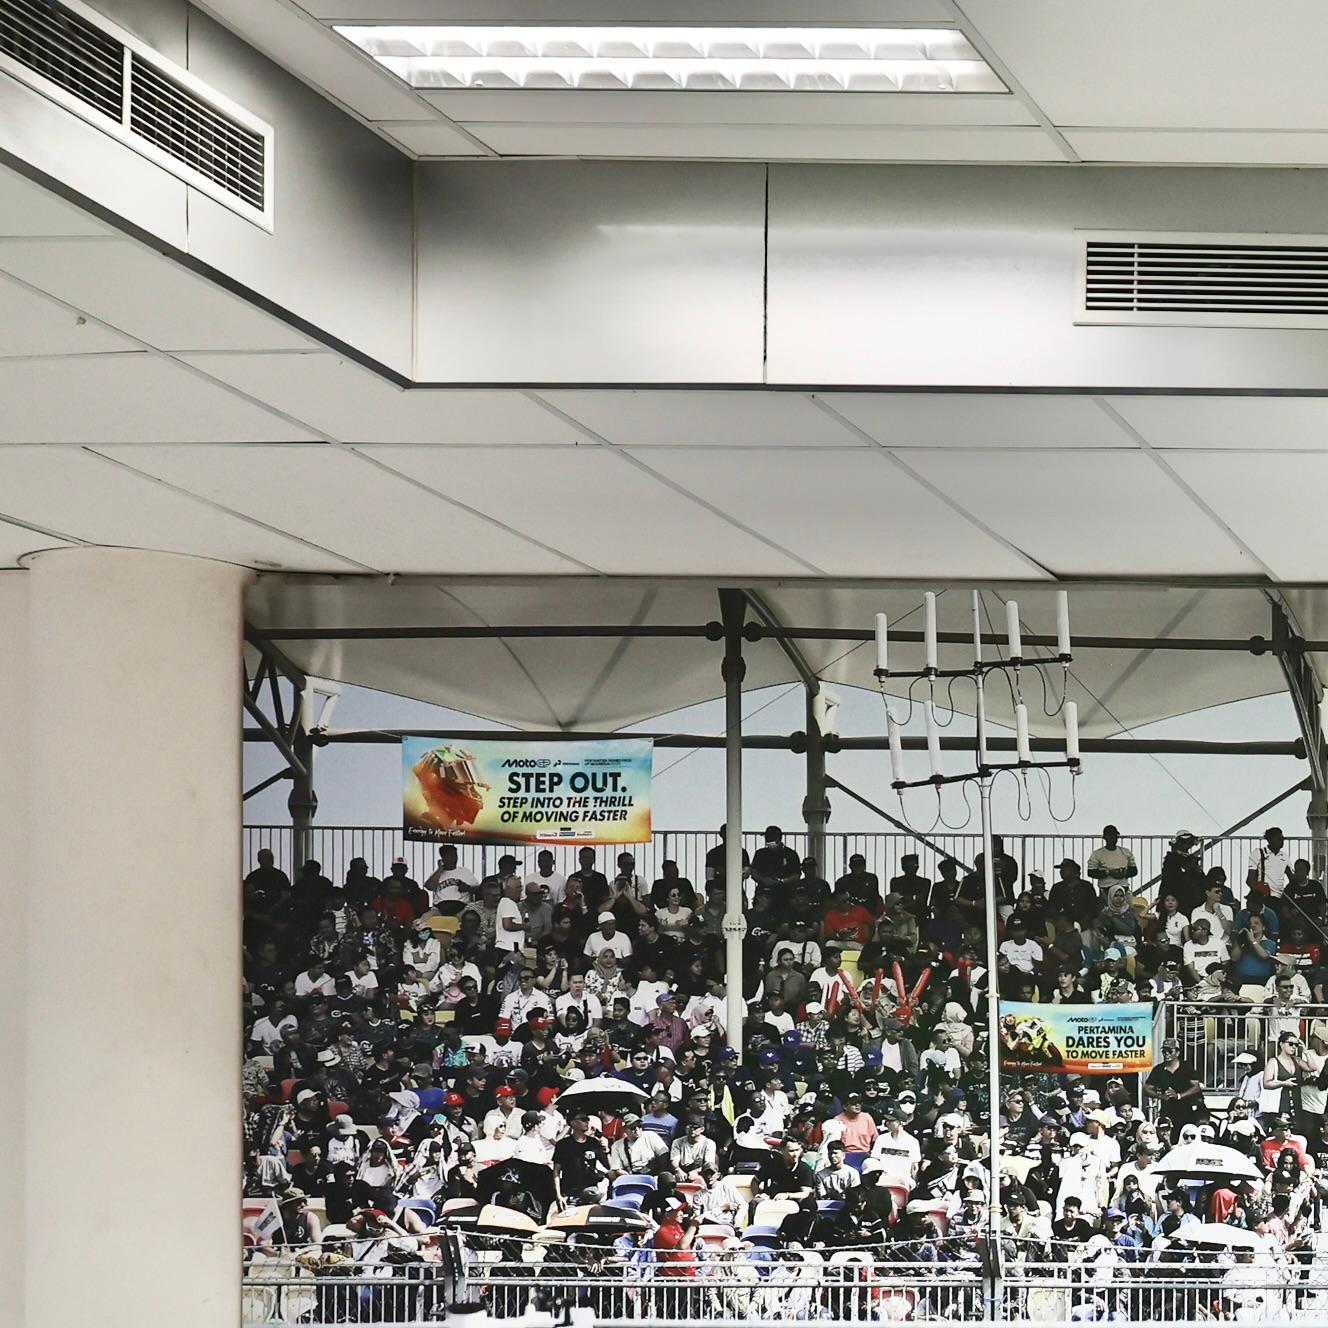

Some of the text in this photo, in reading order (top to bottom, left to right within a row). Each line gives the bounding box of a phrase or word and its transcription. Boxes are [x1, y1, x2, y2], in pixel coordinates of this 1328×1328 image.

[508, 771, 627, 793] STEP OUT.
[498, 795, 634, 809] STEP INTO THE THRILL
[500, 810, 628, 823] OF MOVING FASTER
[1077, 1025, 1135, 1035] PERTAMINA
[1065, 1036, 1146, 1049] DARES YOU
[1066, 1049, 1146, 1059] TO MOVE FASTER
